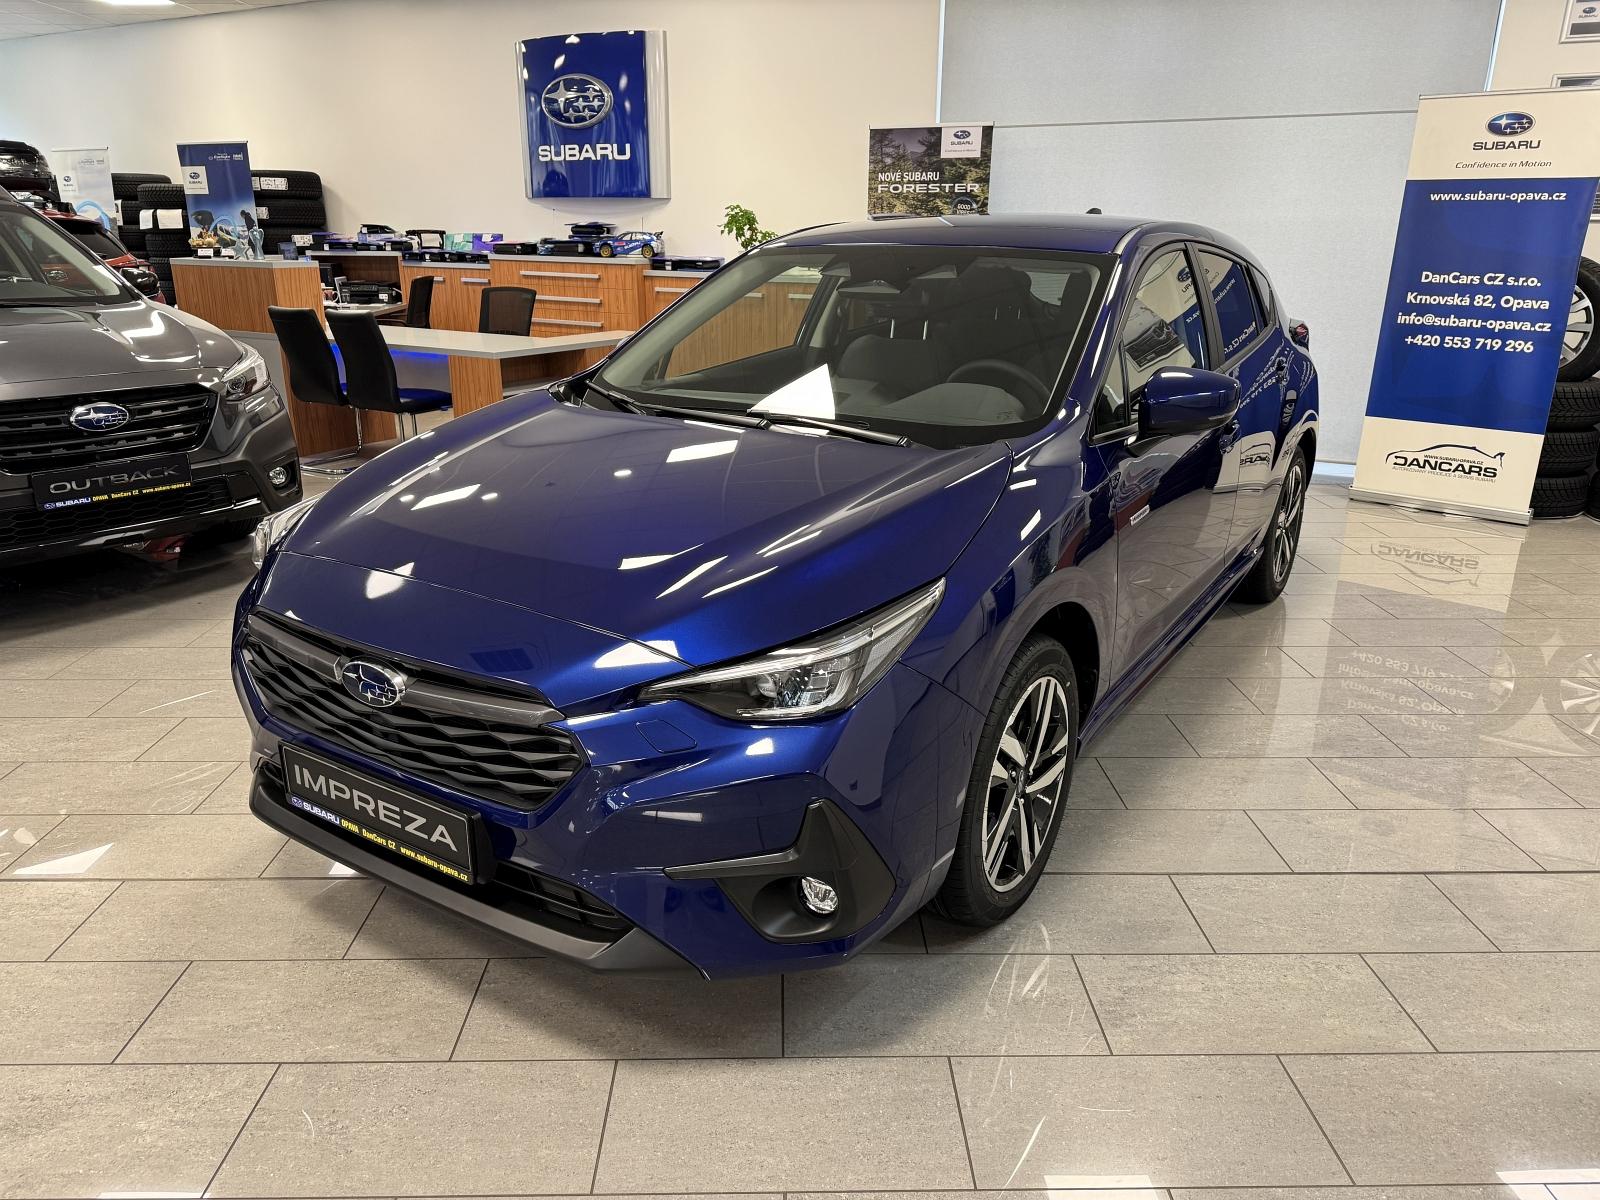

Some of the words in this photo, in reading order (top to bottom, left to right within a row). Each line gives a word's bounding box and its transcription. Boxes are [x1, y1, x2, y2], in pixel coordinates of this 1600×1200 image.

[538, 143, 631, 162] SUBARU
[1472, 140, 1541, 151] SUBARU
[1455, 160, 1507, 169] Confidence
[1518, 160, 1552, 168] Motion
[878, 169, 901, 182] NOVÉ
[903, 172, 940, 181] SUBARU
[877, 183, 980, 194] FORESTER
[1430, 190, 1567, 203] www.subaru-opava.cz
[1421, 271, 1481, 285] DanCars
[1483, 272, 1505, 286] CZ
[1507, 276, 1542, 287] s.r.o.
[1406, 292, 1470, 306] Krnovská
[1473, 294, 1496, 309] 82,
[1500, 295, 1550, 311] Opava
[1397, 312, 1552, 332] info@subaru-opava.cz
[1404, 334, 1441, 347] +420
[1443, 337, 1472, 349] 553
[1475, 338, 1502, 351] 719
[1504, 340, 1534, 353] 296
[49, 464, 180, 494] OUTBACK
[56, 497, 91, 508] SUBARU
[294, 764, 458, 852] IMPREZA
[302, 802, 340, 825] SUBARU
[341, 818, 360, 834] OPAVA
[362, 828, 387, 847] DanCars
[387, 840, 396, 850] CZ
[400, 846, 469, 882] www.subaru-opava.cz
